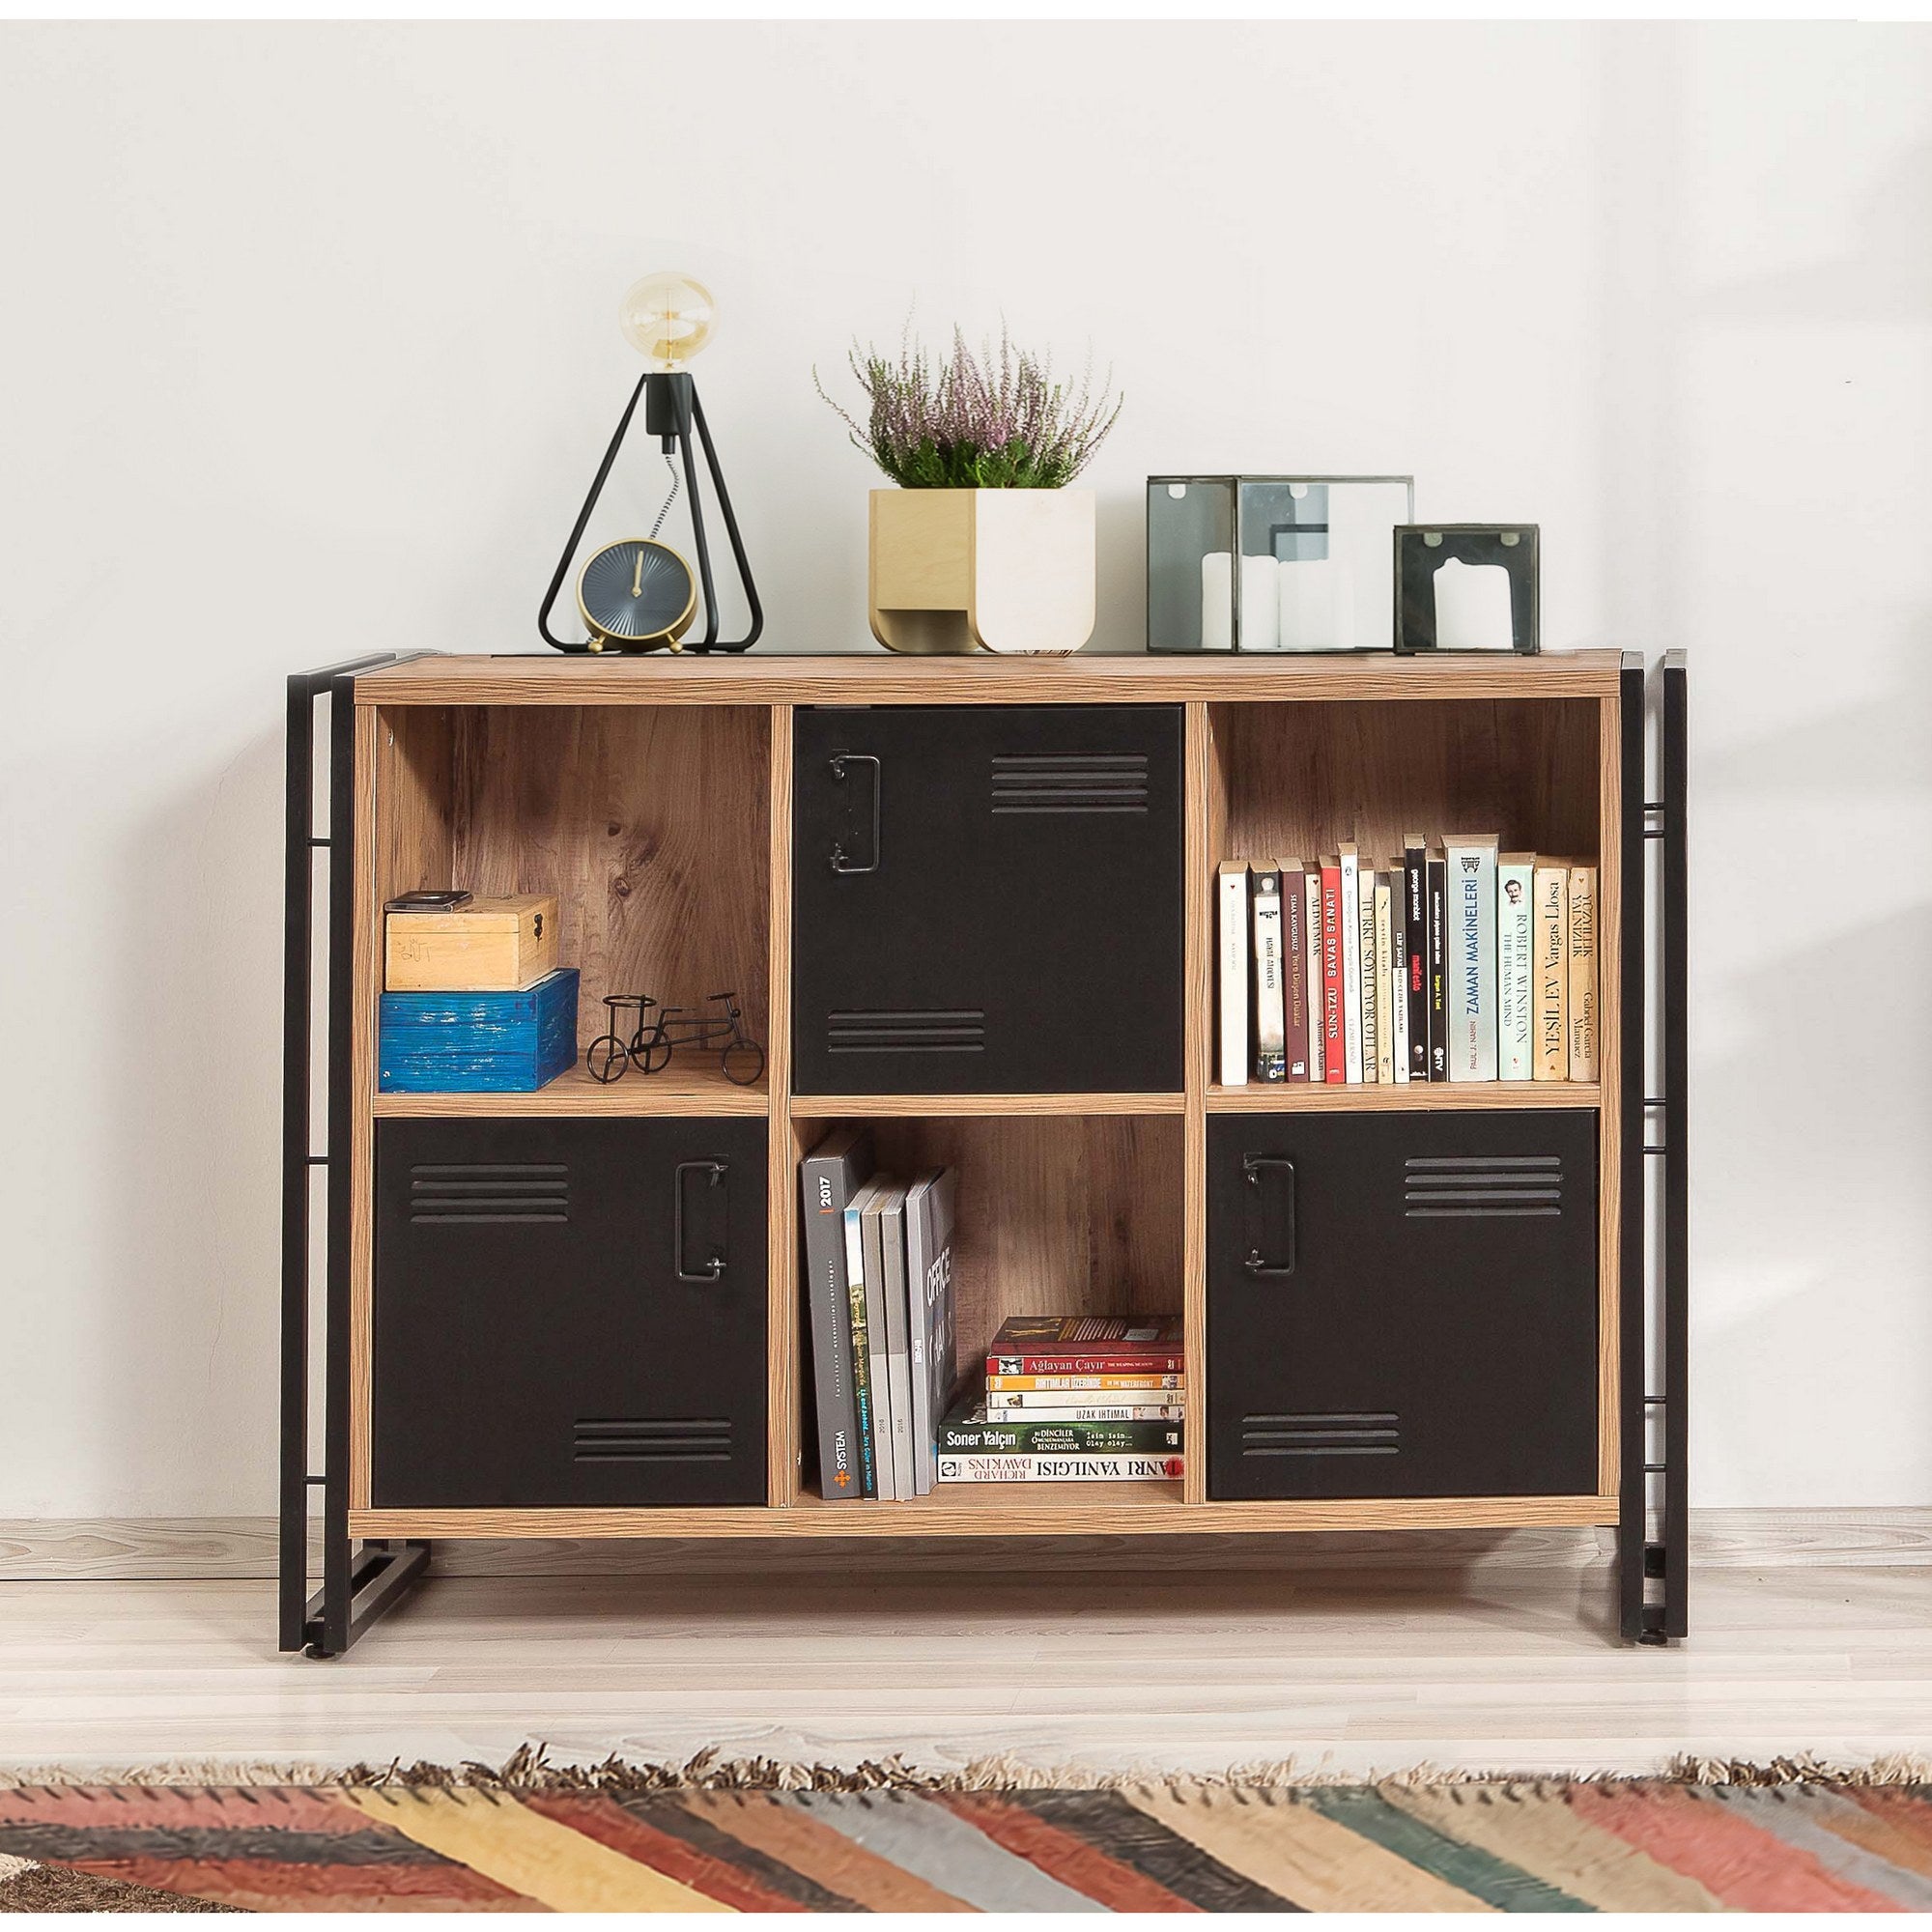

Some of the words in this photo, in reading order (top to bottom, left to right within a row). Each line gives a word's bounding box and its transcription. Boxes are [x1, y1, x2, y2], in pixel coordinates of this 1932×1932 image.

[1410, 868, 1420, 893] george
[1325, 889, 1336, 933] SANATI
[1546, 881, 1559, 920] Llosa
[1312, 896, 1321, 957] ALDATMAK
[1462, 878, 1479, 962] MAKİNELERİ
[1573, 895, 1582, 958] YALNIZLIK
[1503, 932, 1513, 952] THE
[1517, 914, 1527, 970] ROBERT
[1546, 923, 1563, 970] Vargas
[1411, 954, 1423, 991] manifesto
[1465, 966, 1480, 1015] ZAMAN
[1503, 956, 1513, 995] HUMAN
[1546, 976, 1559, 1000] EV
[1327, 987, 1338, 1039] SUN-TZU
[1504, 999, 1514, 1027] MIND
[1517, 975, 1528, 1043] WINSTON
[1583, 992, 1594, 1026] Gabriel
[1364, 1023, 1377, 1070] OTLAR
[1544, 1003, 1562, 1057] YEŞİL
[1469, 1052, 1478, 1070] PAUL
[819, 1176, 833, 1208] 2017
[1030, 1360, 1072, 1373] Ağlayan
[1075, 1359, 1105, 1374] Çayır
[1041, 1429, 1074, 1437] DİNCİLER
[1076, 1410, 1096, 1420] UZAK
[835, 1431, 847, 1470] SYSTEM
[947, 1432, 981, 1446] Soner
[982, 1432, 1016, 1450] Yalçın
[968, 1459, 1032, 1470] DAWKINS
[974, 1468, 1026, 1480] RICHARD
[1037, 1463, 1120, 1476] YANILGISI
